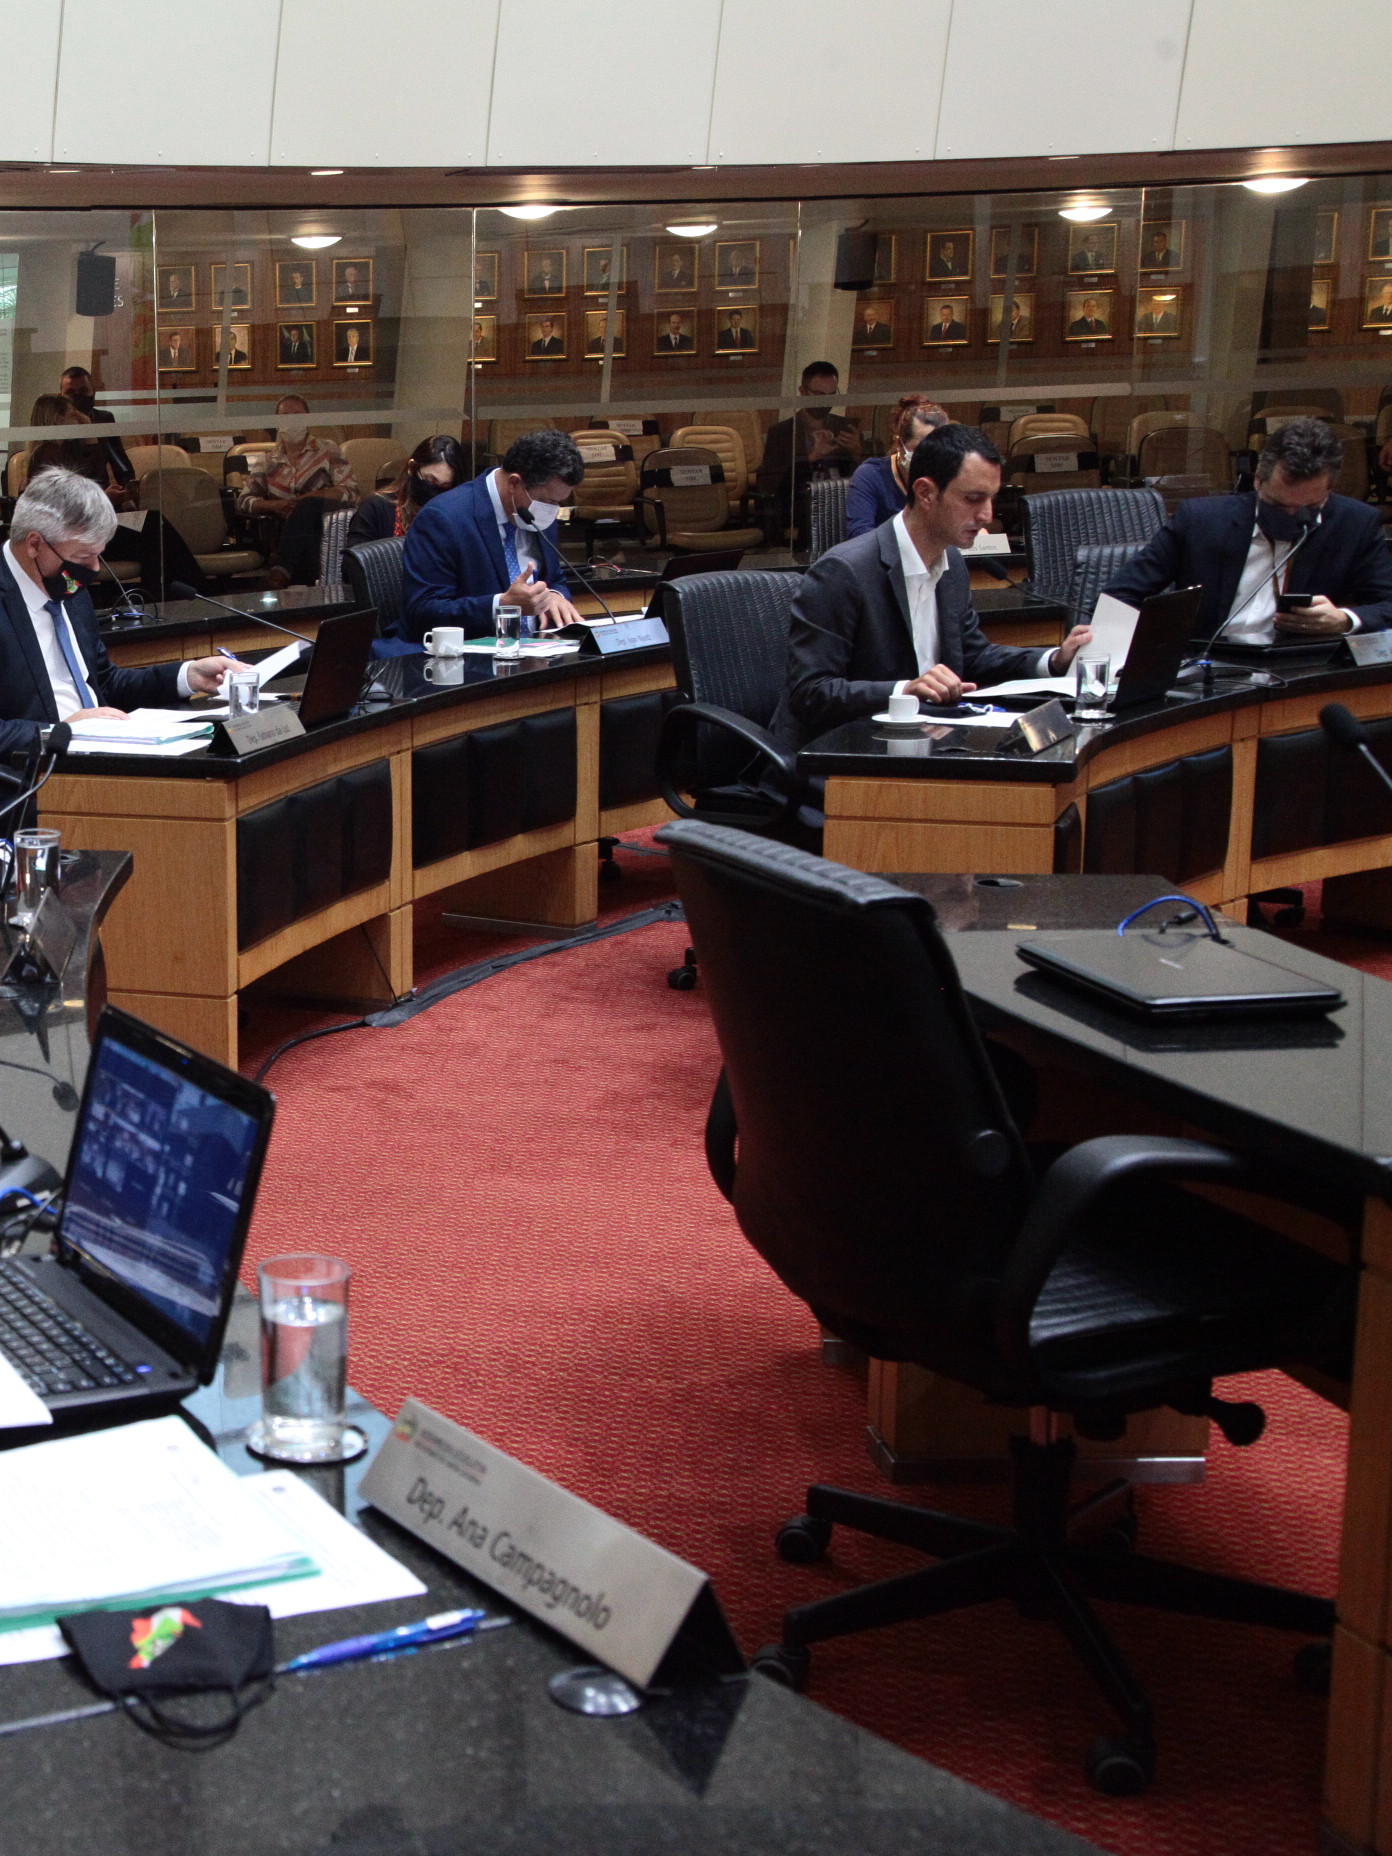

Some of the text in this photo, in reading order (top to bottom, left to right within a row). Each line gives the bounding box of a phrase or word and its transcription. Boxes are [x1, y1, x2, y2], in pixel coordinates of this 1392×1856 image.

[406, 1476, 612, 1631] Dep. Ana Campagnolo
